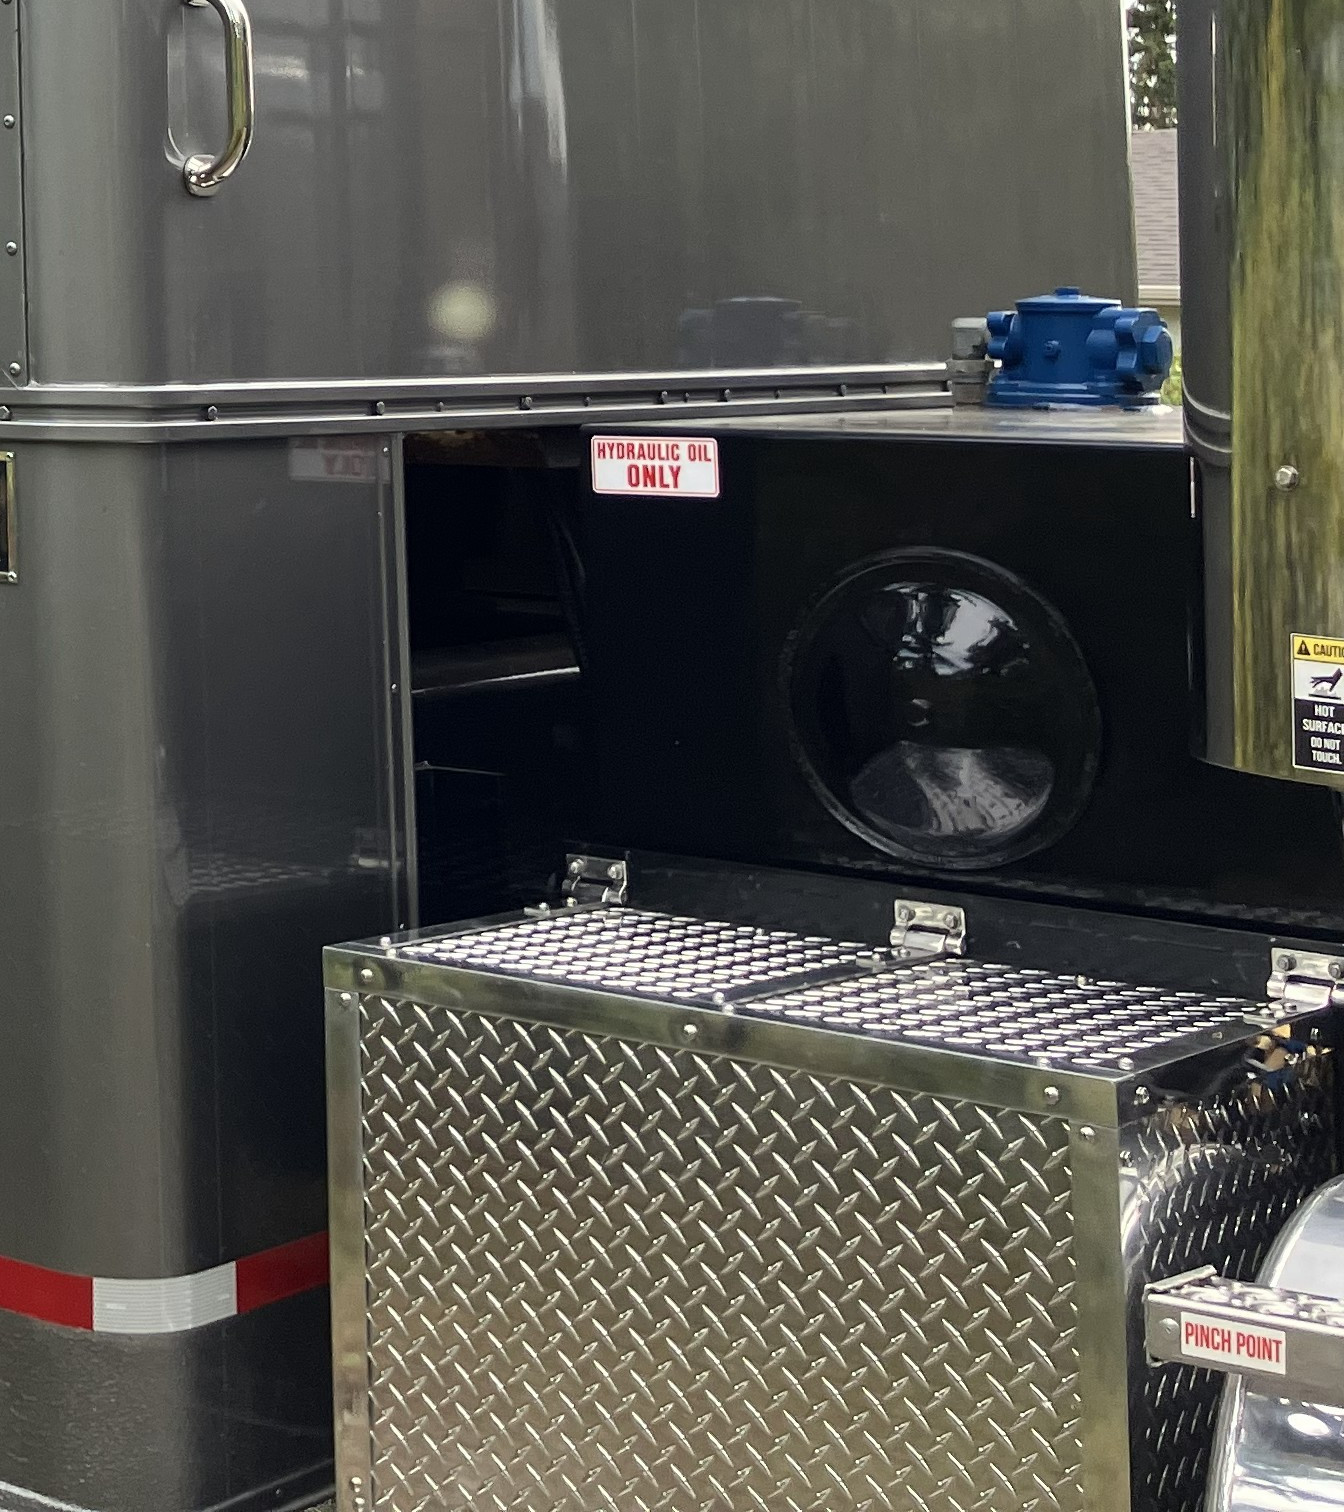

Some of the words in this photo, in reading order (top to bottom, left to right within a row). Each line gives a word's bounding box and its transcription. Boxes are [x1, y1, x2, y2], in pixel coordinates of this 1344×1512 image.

[597, 442, 680, 461] HYDRAULIC
[688, 443, 712, 462] OIL
[627, 464, 681, 489] ONLY
[1314, 704, 1336, 718] HOT
[1310, 736, 1322, 748] DO
[1323, 738, 1341, 751] NOT
[1184, 1321, 1231, 1353] PINCH
[1236, 1332, 1282, 1363] POINT
